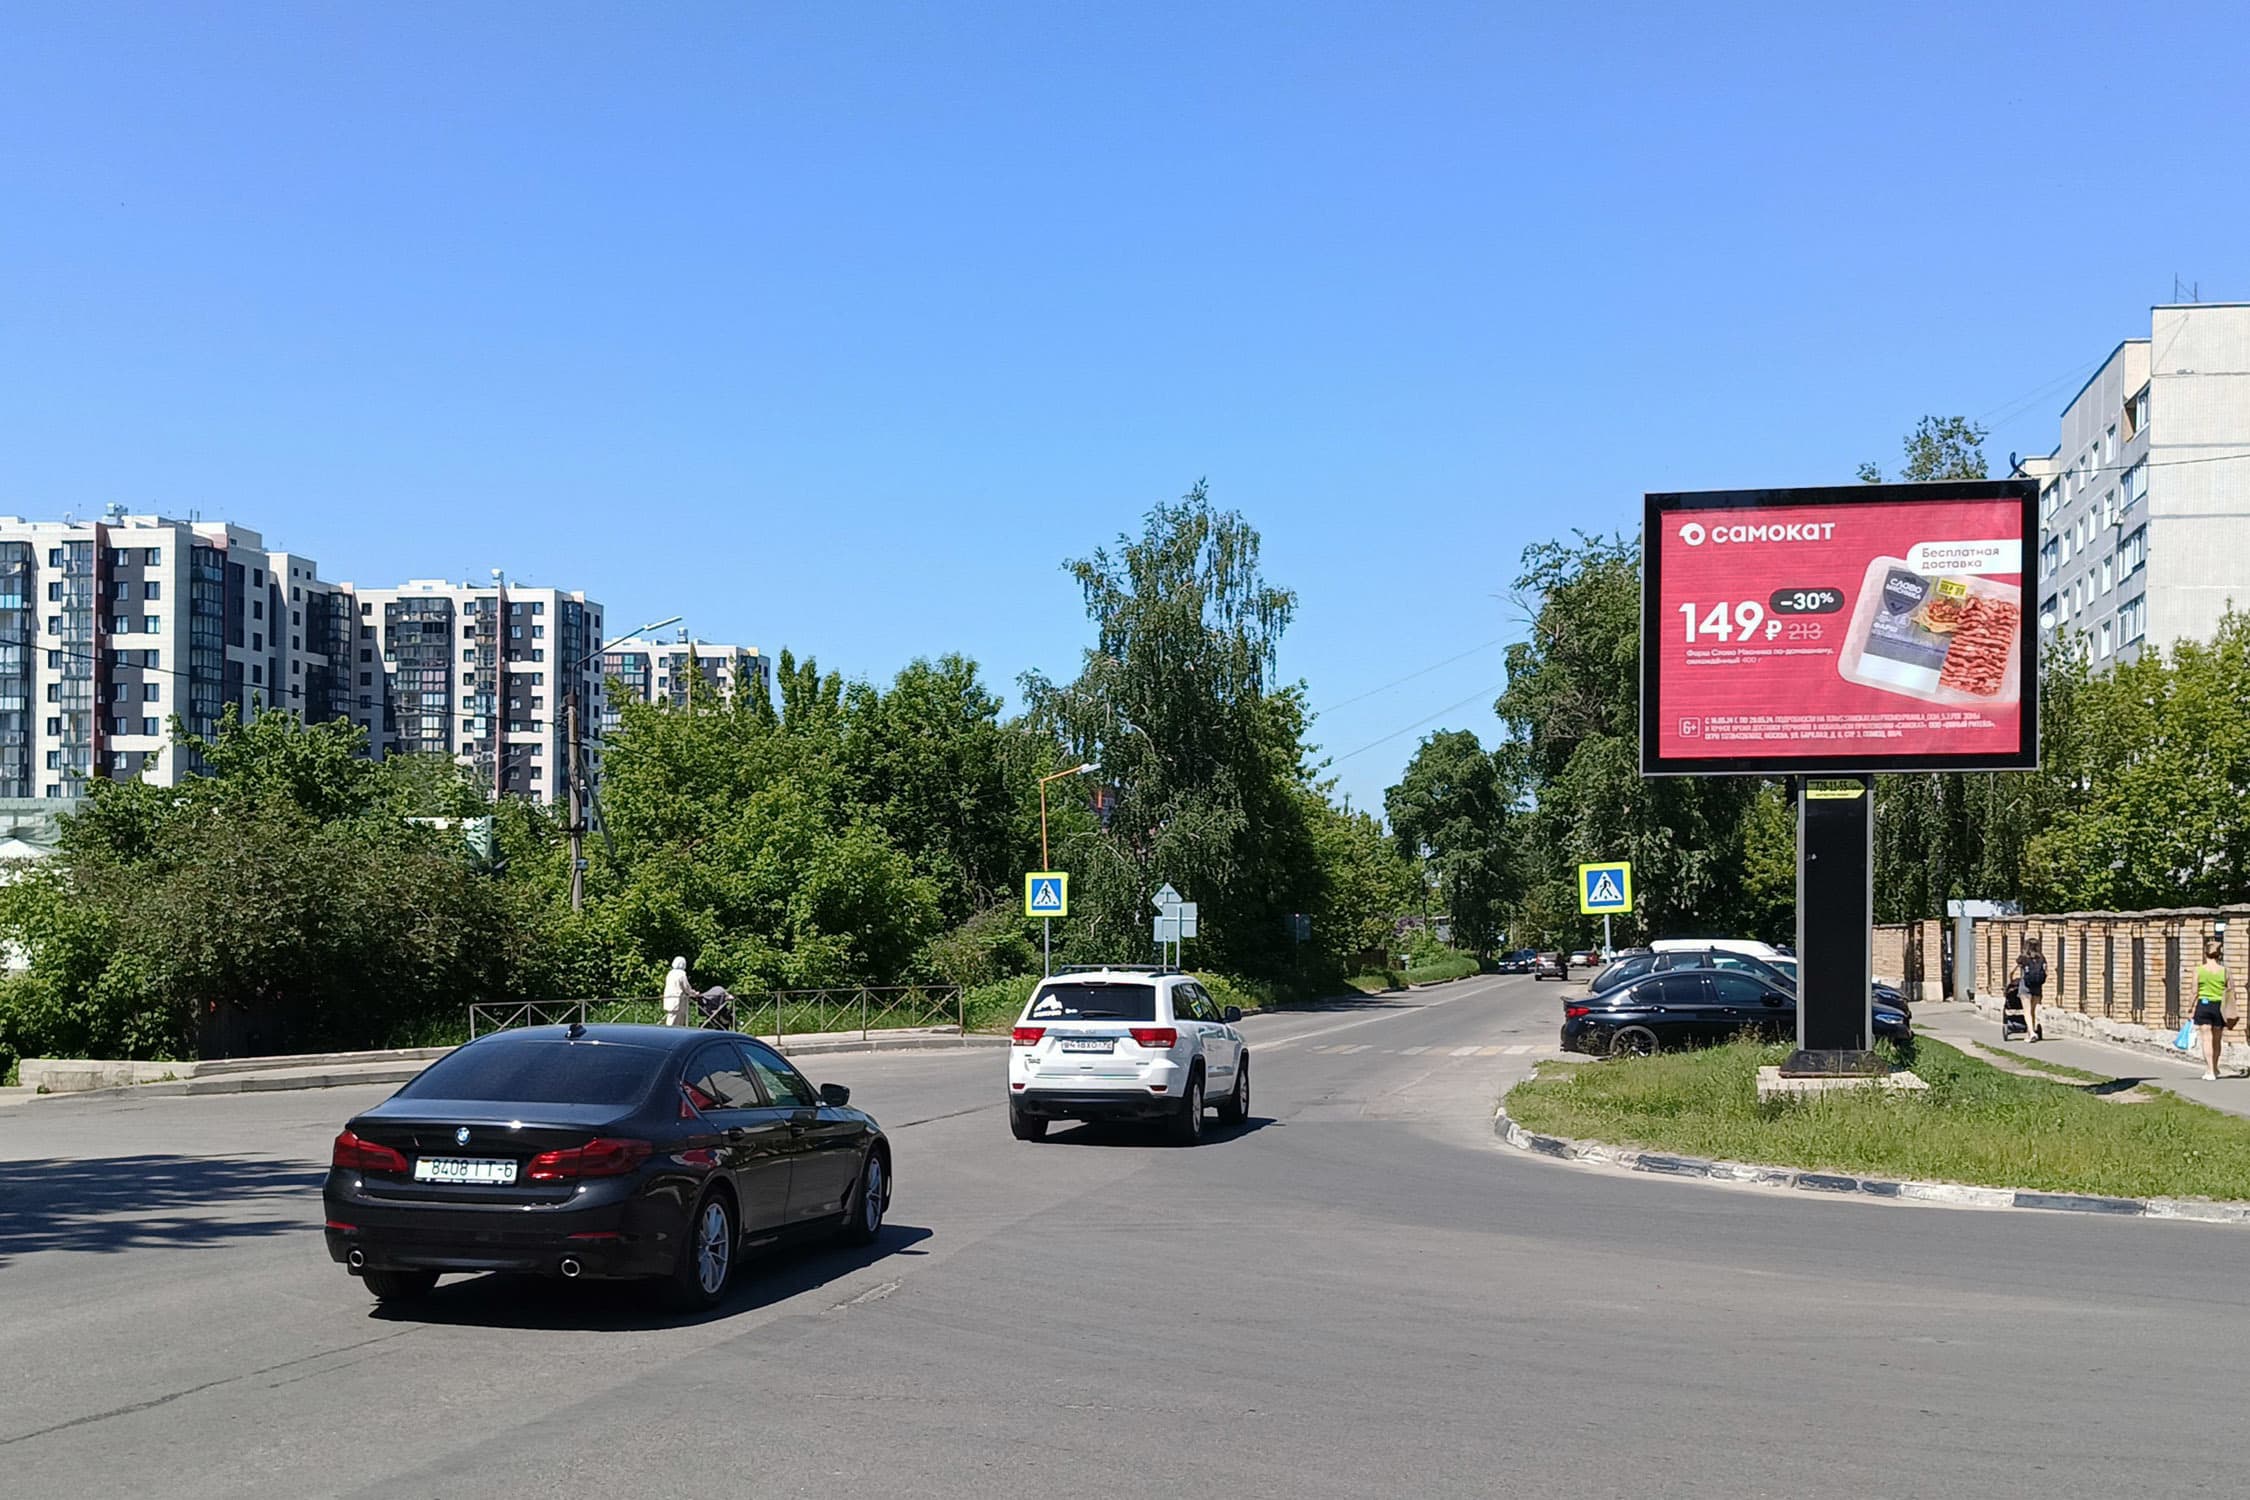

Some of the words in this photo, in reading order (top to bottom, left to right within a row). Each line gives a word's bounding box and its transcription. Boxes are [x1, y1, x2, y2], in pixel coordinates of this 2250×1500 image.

[1921, 546, 2001, 558] Бесплатная
[1921, 559, 1983, 570] доставка
[1788, 622, 1823, 641] 213
[1742, 656, 1757, 664] 400
[1682, 720, 1698, 735] 6+
[431, 1158, 469, 1176] 8408
